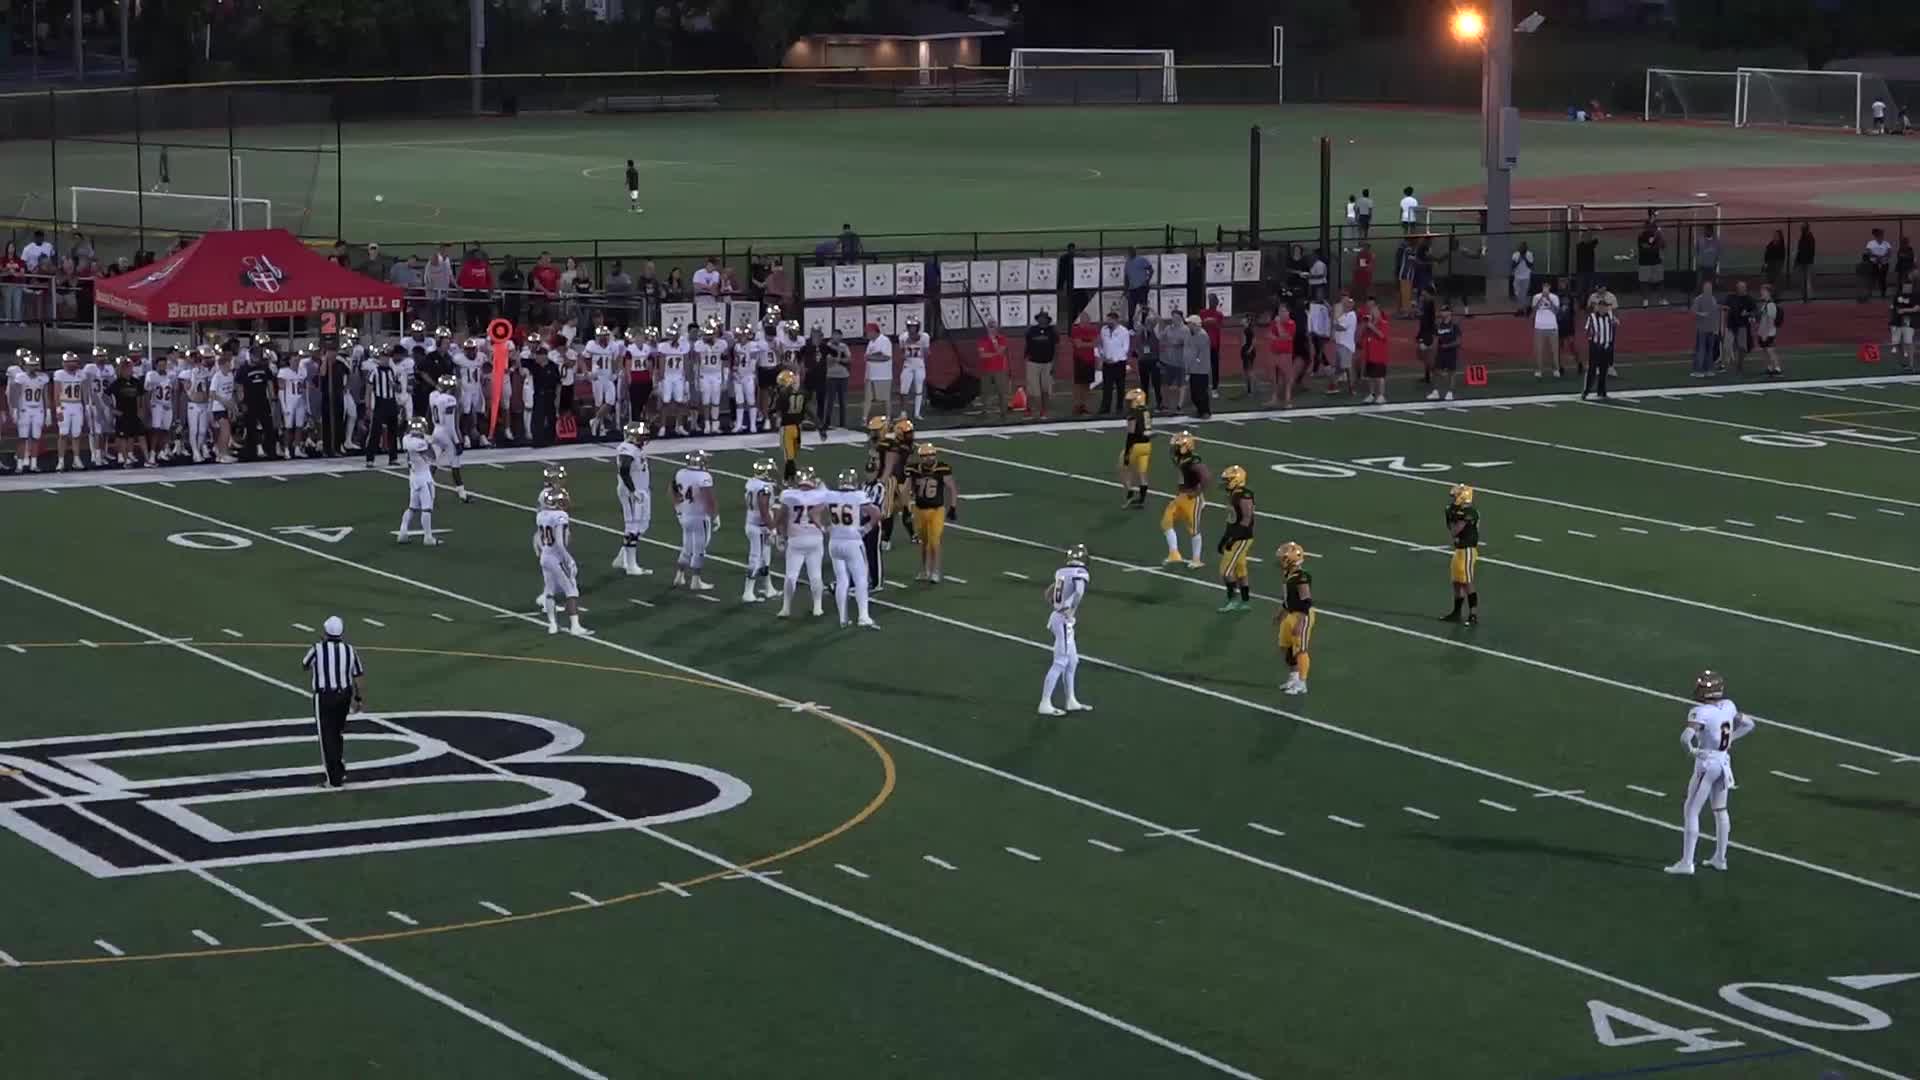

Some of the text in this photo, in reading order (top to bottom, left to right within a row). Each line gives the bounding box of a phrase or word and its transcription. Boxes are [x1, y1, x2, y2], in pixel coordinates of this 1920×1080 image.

[168, 296, 388, 318] BERGEN CATHOLIC FOOTBALL
[321, 312, 337, 334] 2
[1470, 366, 1484, 381] 10
[25, 388, 42, 402] 80
[1270, 456, 1450, 478] 20
[914, 476, 938, 500] 76
[828, 503, 854, 526] 56
[166, 525, 354, 550] 40
[1719, 722, 1731, 752] 6
[1587, 982, 1892, 1053] 40
